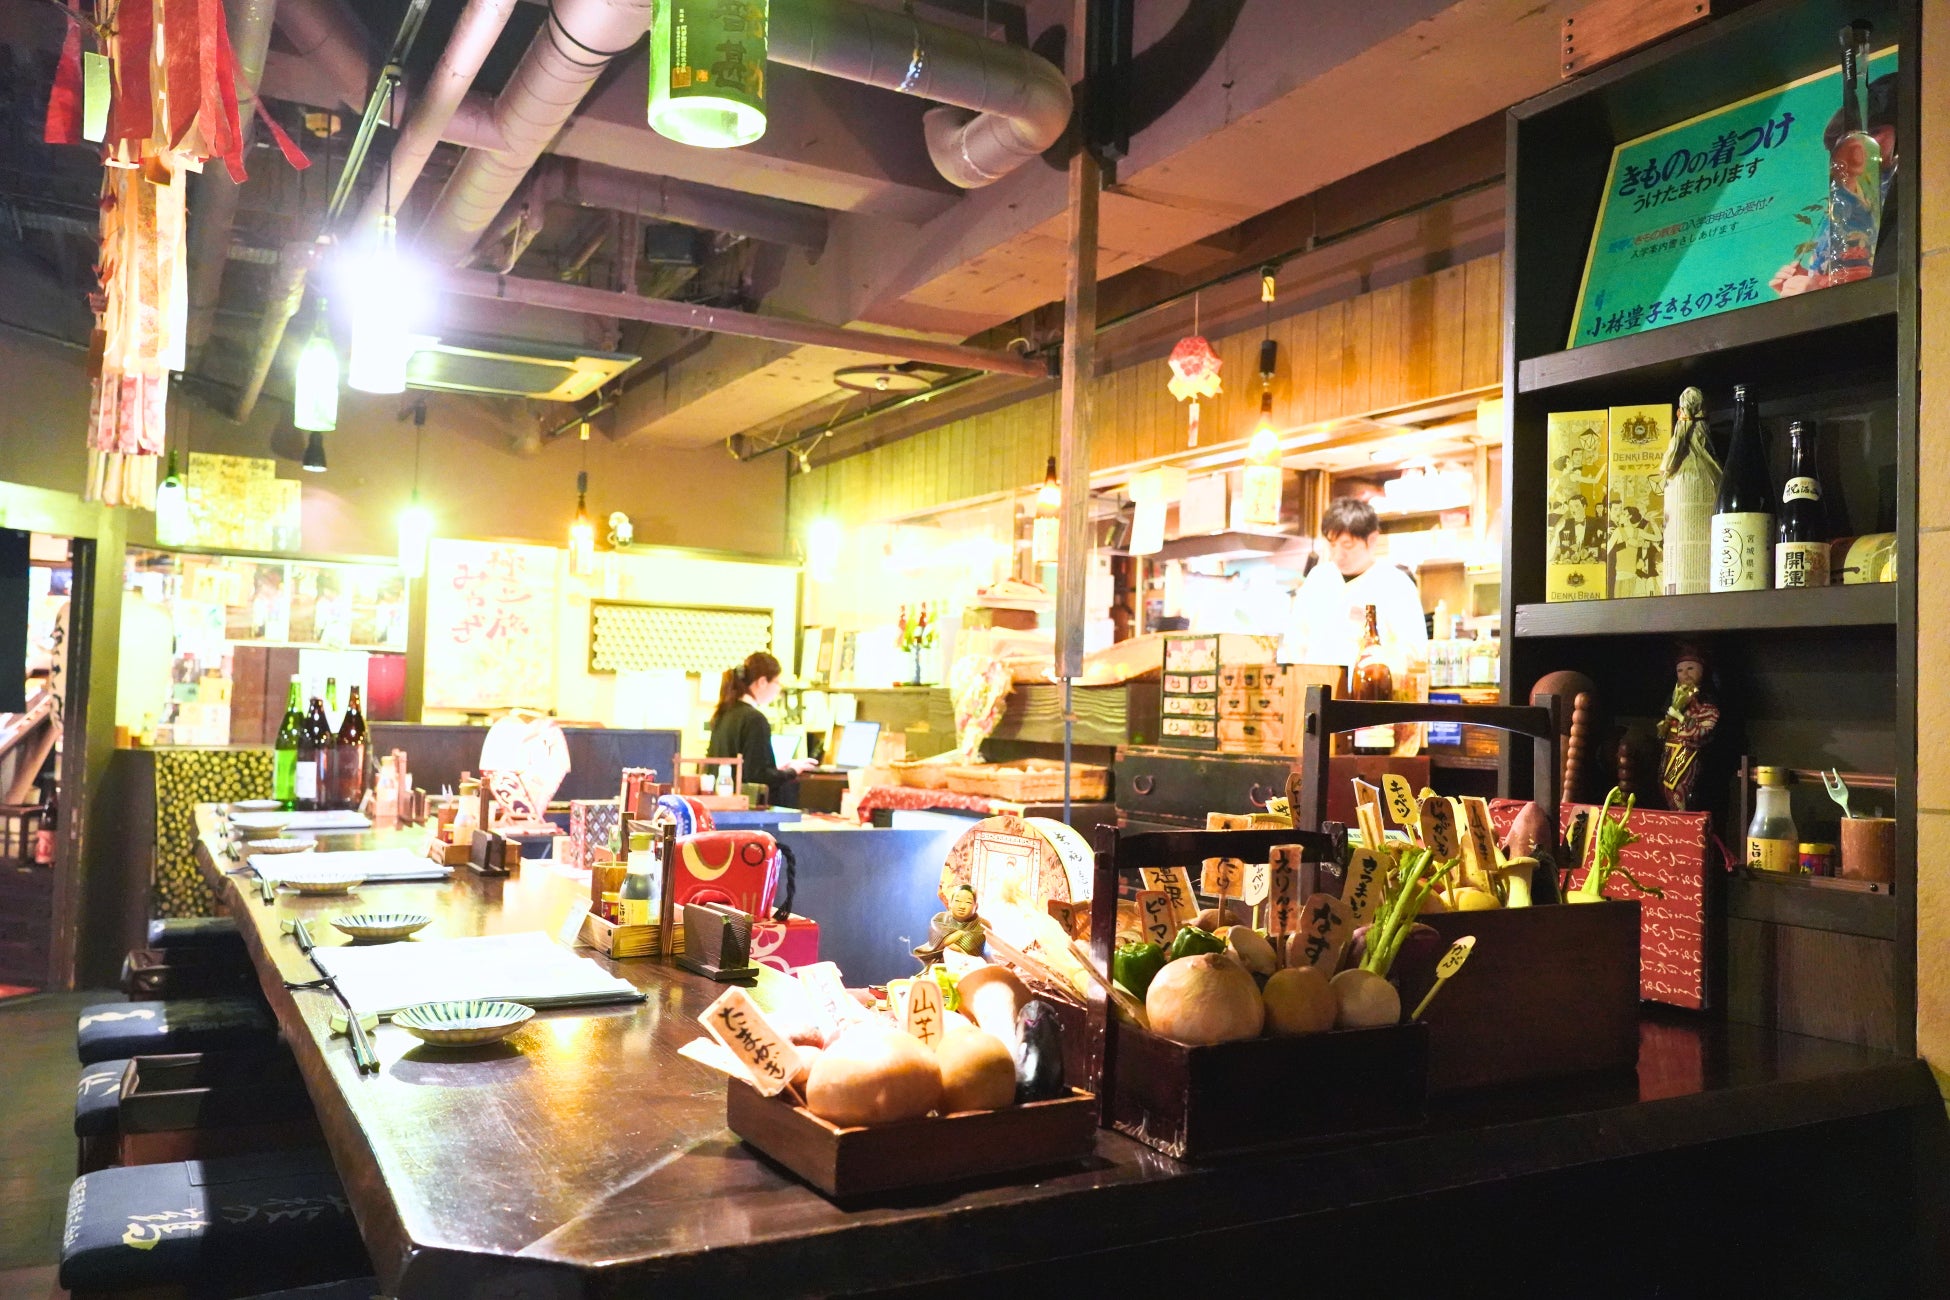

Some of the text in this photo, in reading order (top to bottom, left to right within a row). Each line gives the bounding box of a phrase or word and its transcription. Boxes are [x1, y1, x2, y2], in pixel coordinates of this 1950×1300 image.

[1619, 111, 1796, 197] きものの着つけ
[1633, 157, 1764, 214] うけたまわります
[1586, 277, 1760, 338] 小林豊子きもの学院
[1613, 452, 1640, 462] DENKI
[1551, 591, 1601, 601] DENKI BRAN
[1783, 550, 1806, 588] 開運
[1389, 779, 1411, 818] キャベツ
[1275, 849, 1294, 928] えりんぎ
[1145, 896, 1171, 953] ピーマン
[1304, 902, 1342, 966] なす
[1442, 944, 1467, 969] かぶ
[718, 1007, 786, 1080] たまねぎ
[913, 987, 937, 1045] 山芋
